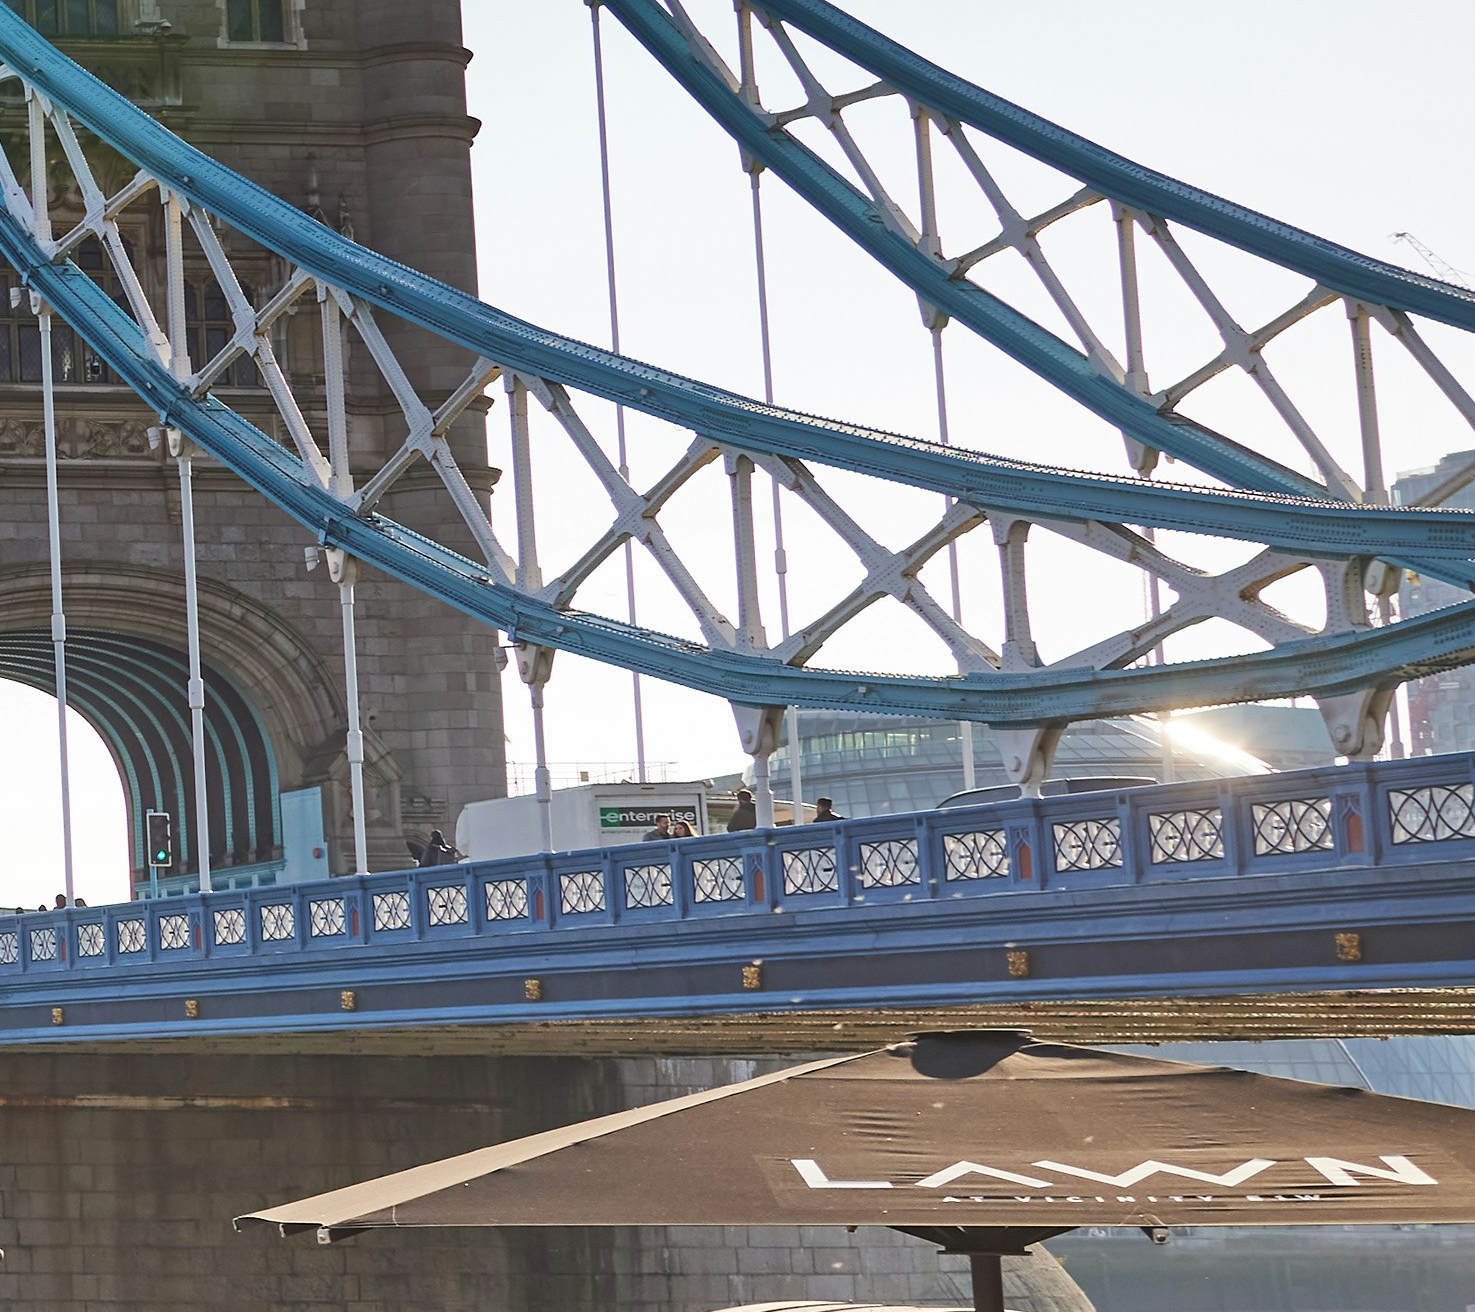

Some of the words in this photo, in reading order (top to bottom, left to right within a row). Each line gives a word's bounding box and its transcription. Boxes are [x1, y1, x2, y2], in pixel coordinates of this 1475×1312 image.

[790, 1155, 1440, 1189] LAWN
[941, 1195, 987, 1204] AT
[1020, 1194, 1215, 1204] VICINITY
